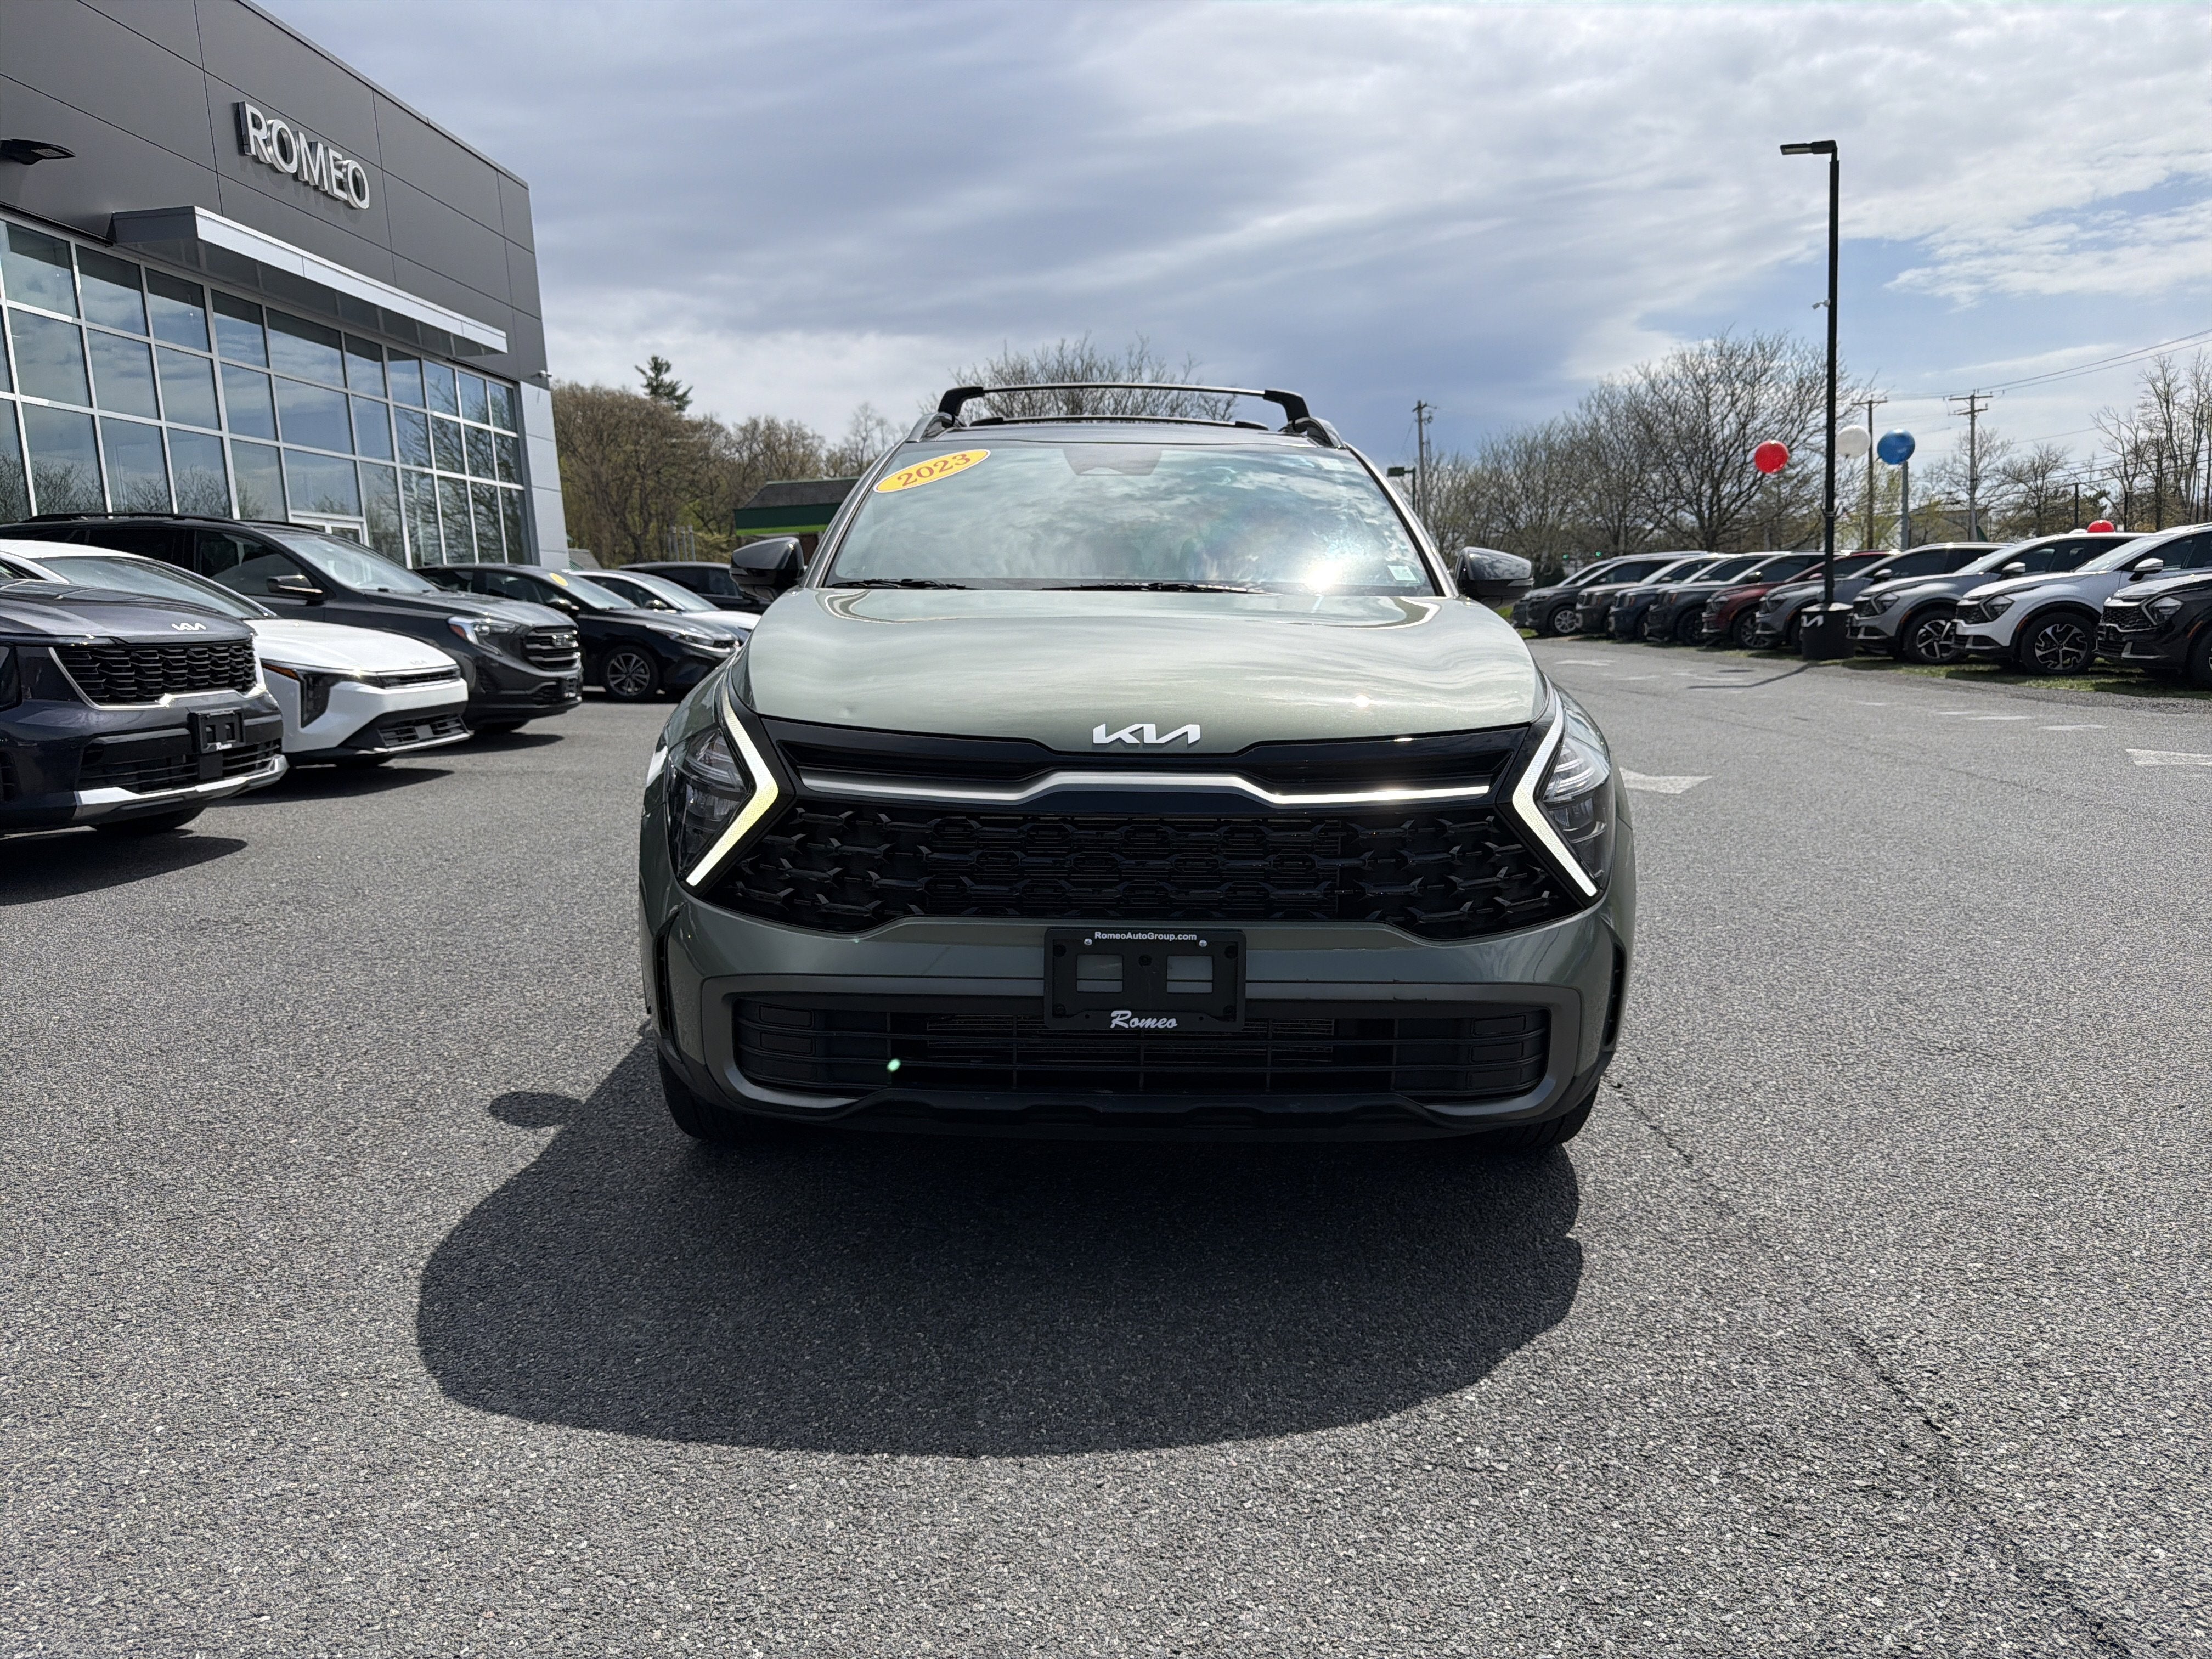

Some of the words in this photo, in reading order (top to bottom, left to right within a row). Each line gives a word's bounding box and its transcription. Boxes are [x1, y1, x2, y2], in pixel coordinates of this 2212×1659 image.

[243, 101, 370, 210] ROMEO
[897, 454, 971, 487] 2023
[171, 622, 206, 631] KIA
[1093, 723, 1201, 744] KIA
[1094, 931, 1197, 941] RomeoAutoGroup.com
[1110, 1010, 1178, 1029] Romeo
